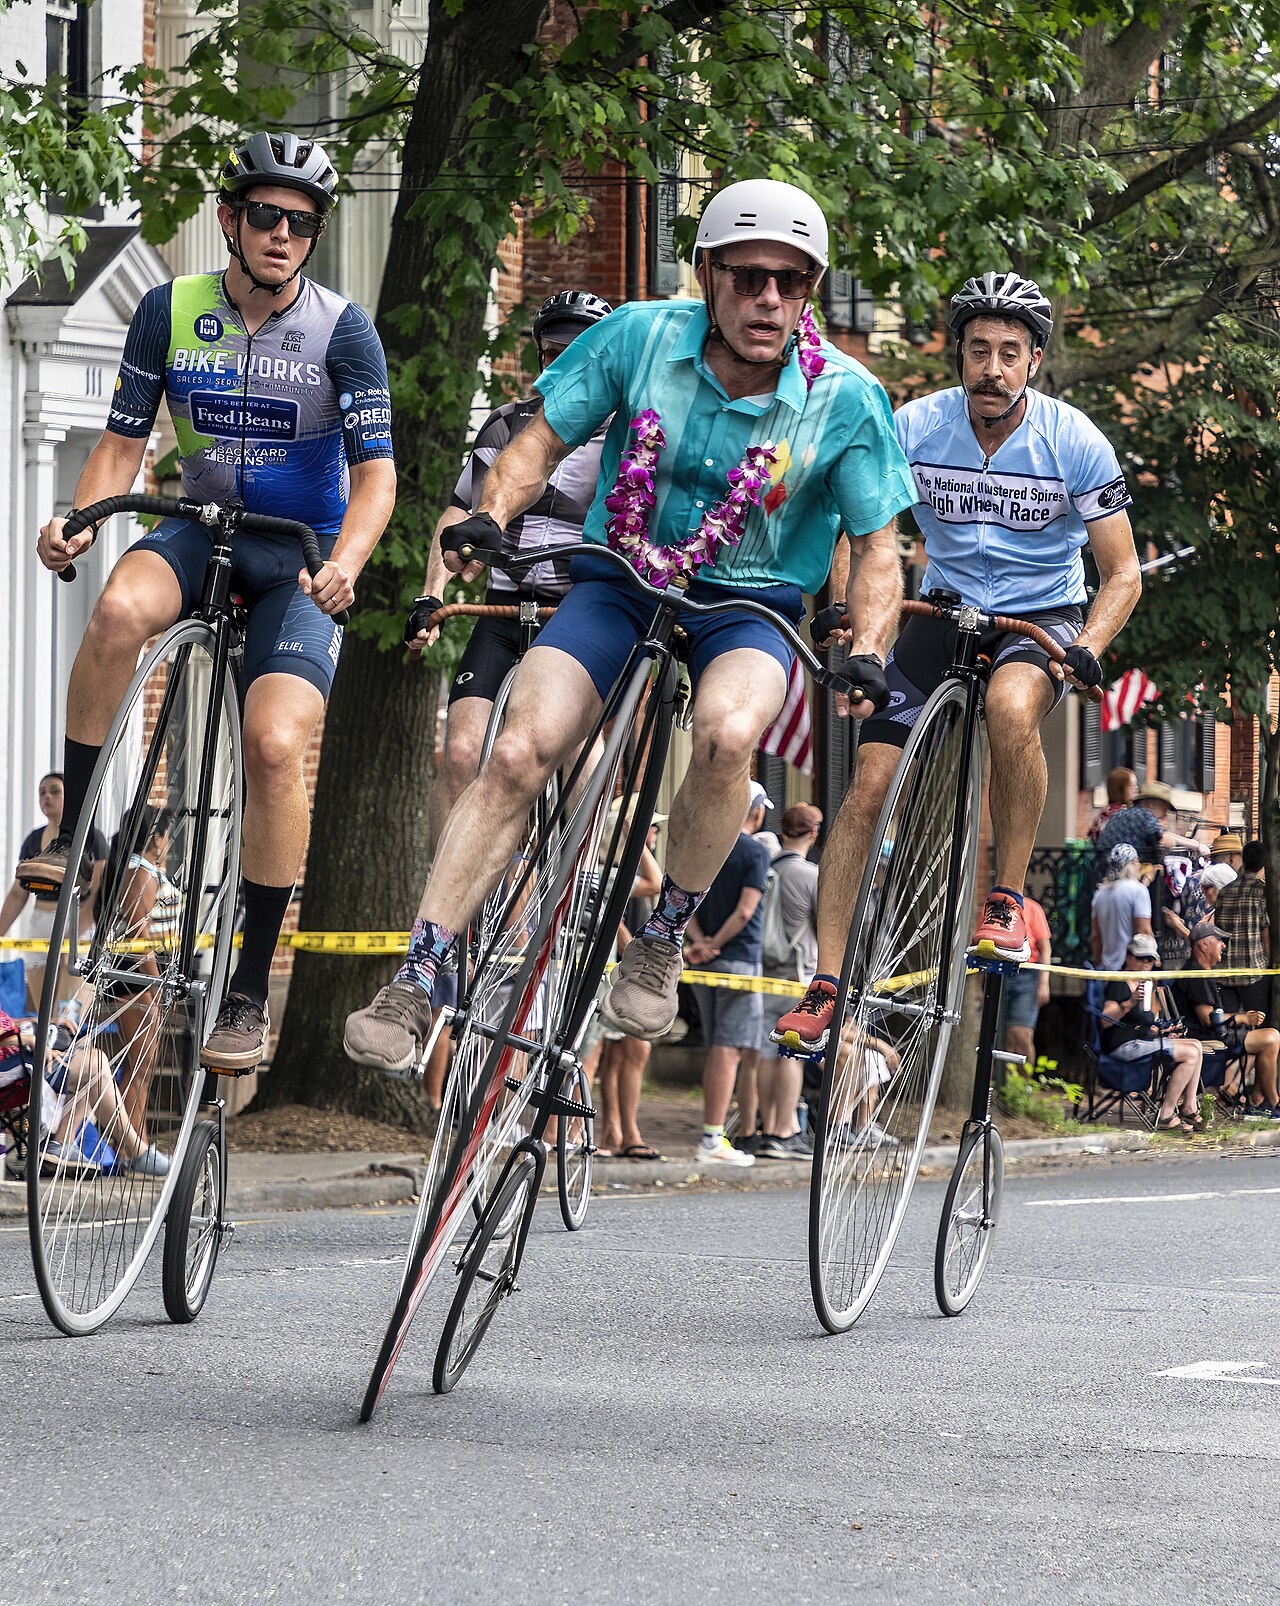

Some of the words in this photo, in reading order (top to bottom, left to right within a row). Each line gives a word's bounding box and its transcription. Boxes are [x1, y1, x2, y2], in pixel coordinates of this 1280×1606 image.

[199, 318, 218, 336] 100
[281, 341, 302, 353] ELIEL
[172, 349, 229, 374] BIKE
[236, 353, 321, 386] WORKS
[176, 376, 203, 384] SALES
[215, 377, 252, 388] SERVICE
[263, 382, 315, 396] COMMUNITY
[355, 390, 367, 398] Dr.
[368, 388, 382, 396] Rob
[230, 400, 259, 408] BETTER
[197, 407, 235, 424] Fred
[237, 411, 291, 430] Beans
[217, 445, 287, 457] BACKYARD
[216, 453, 265, 466] BEANS
[934, 476, 975, 494] National
[1030, 487, 1065, 504] Spires
[959, 495, 1005, 519] Wheel
[1009, 501, 1050, 522] Race
[278, 641, 304, 652] ELIEL
